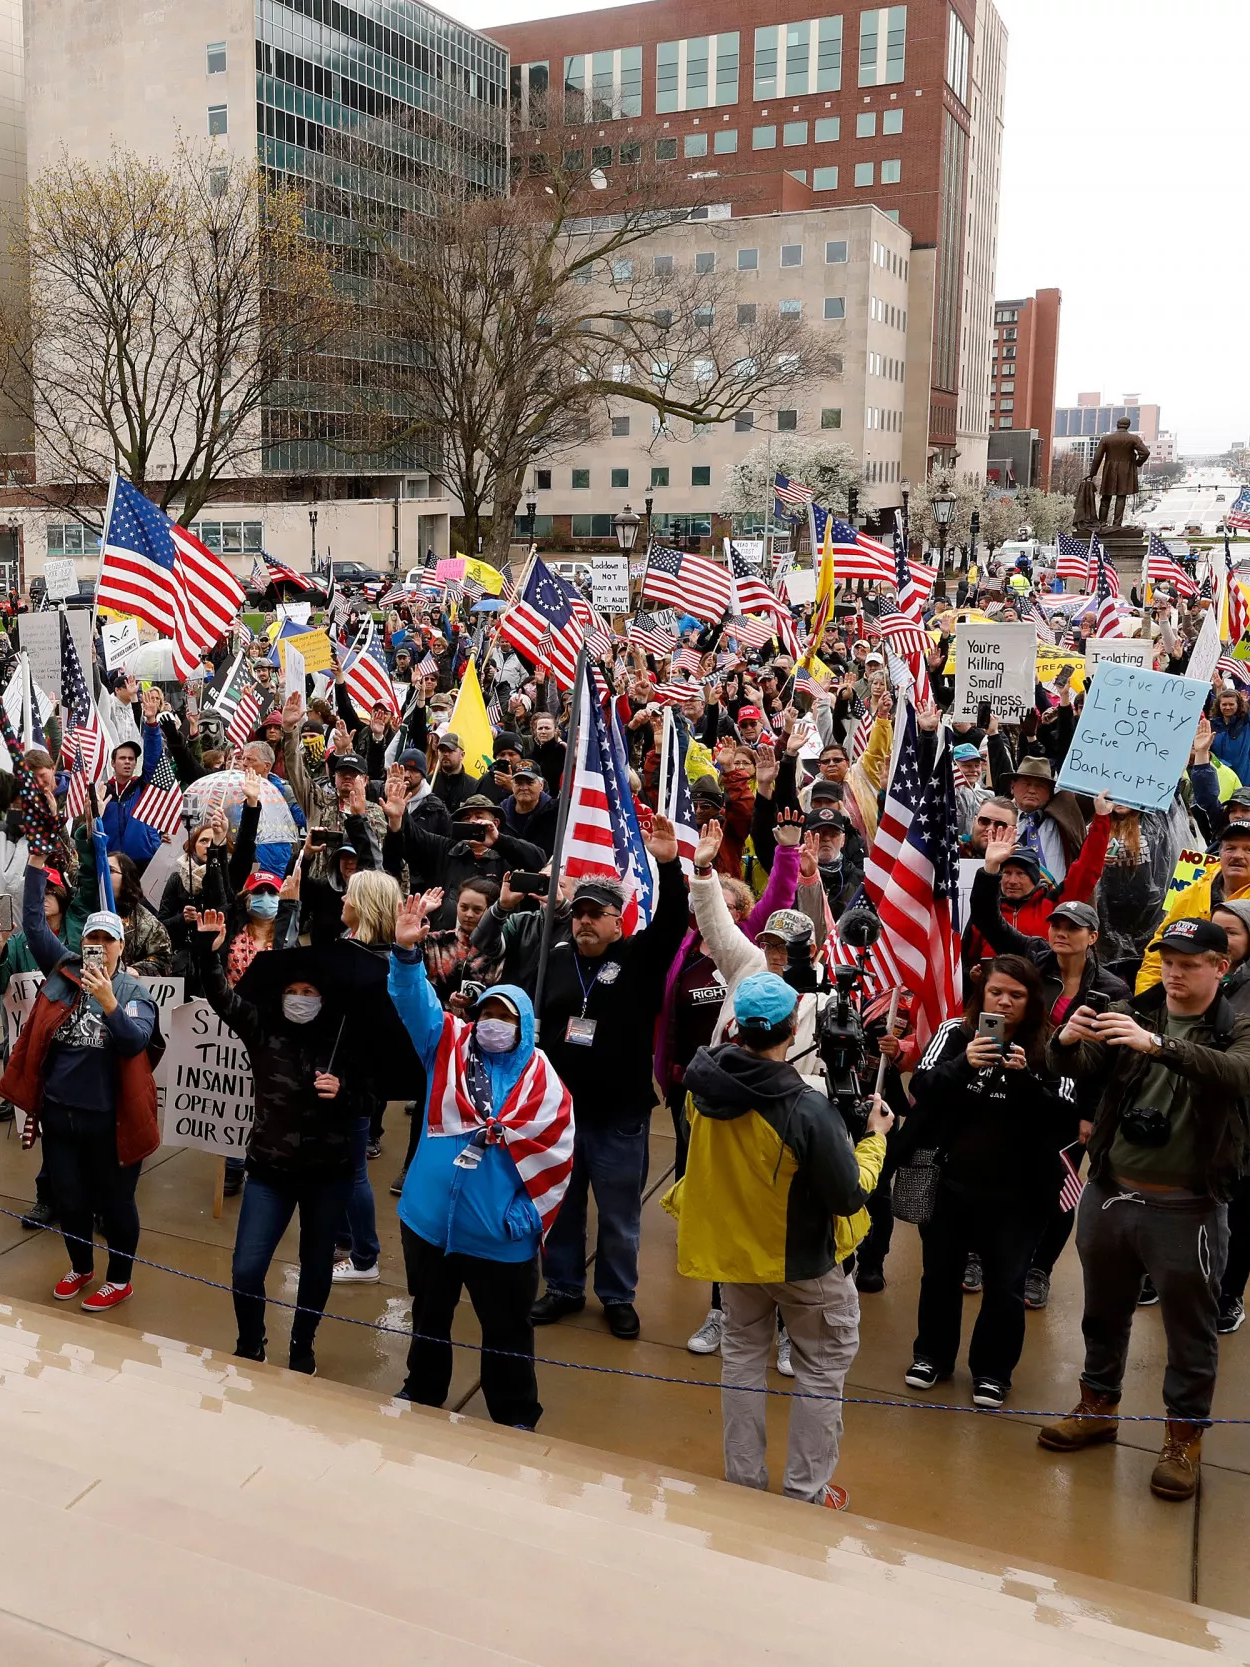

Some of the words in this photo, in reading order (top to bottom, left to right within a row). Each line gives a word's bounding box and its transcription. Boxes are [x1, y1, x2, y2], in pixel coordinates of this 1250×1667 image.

[592, 560, 618, 570] Lockdown
[594, 604, 628, 612] CONTROL!
[658, 608, 676, 626] OUR
[967, 640, 1000, 654] You're
[968, 657, 1004, 672] Killing
[1092, 652, 1144, 666] Isolating
[969, 674, 1002, 688] Small
[1103, 668, 1152, 692] Give
[1162, 679, 1196, 701] Me
[966, 691, 1024, 706] Business.
[1094, 689, 1192, 730] Liberty
[1082, 730, 1118, 748] Give
[1114, 720, 1151, 741] OR
[1070, 749, 1176, 802] Bankruptcy
[1179, 850, 1204, 865] NO
[153, 984, 176, 1006] UP
[693, 988, 728, 1000] RIGHT
[192, 1009, 240, 1039] STO
[196, 1043, 251, 1072] THIS
[177, 1065, 254, 1098] INSANIT
[174, 1094, 226, 1118] OPEN
[176, 1118, 219, 1143] OUR
